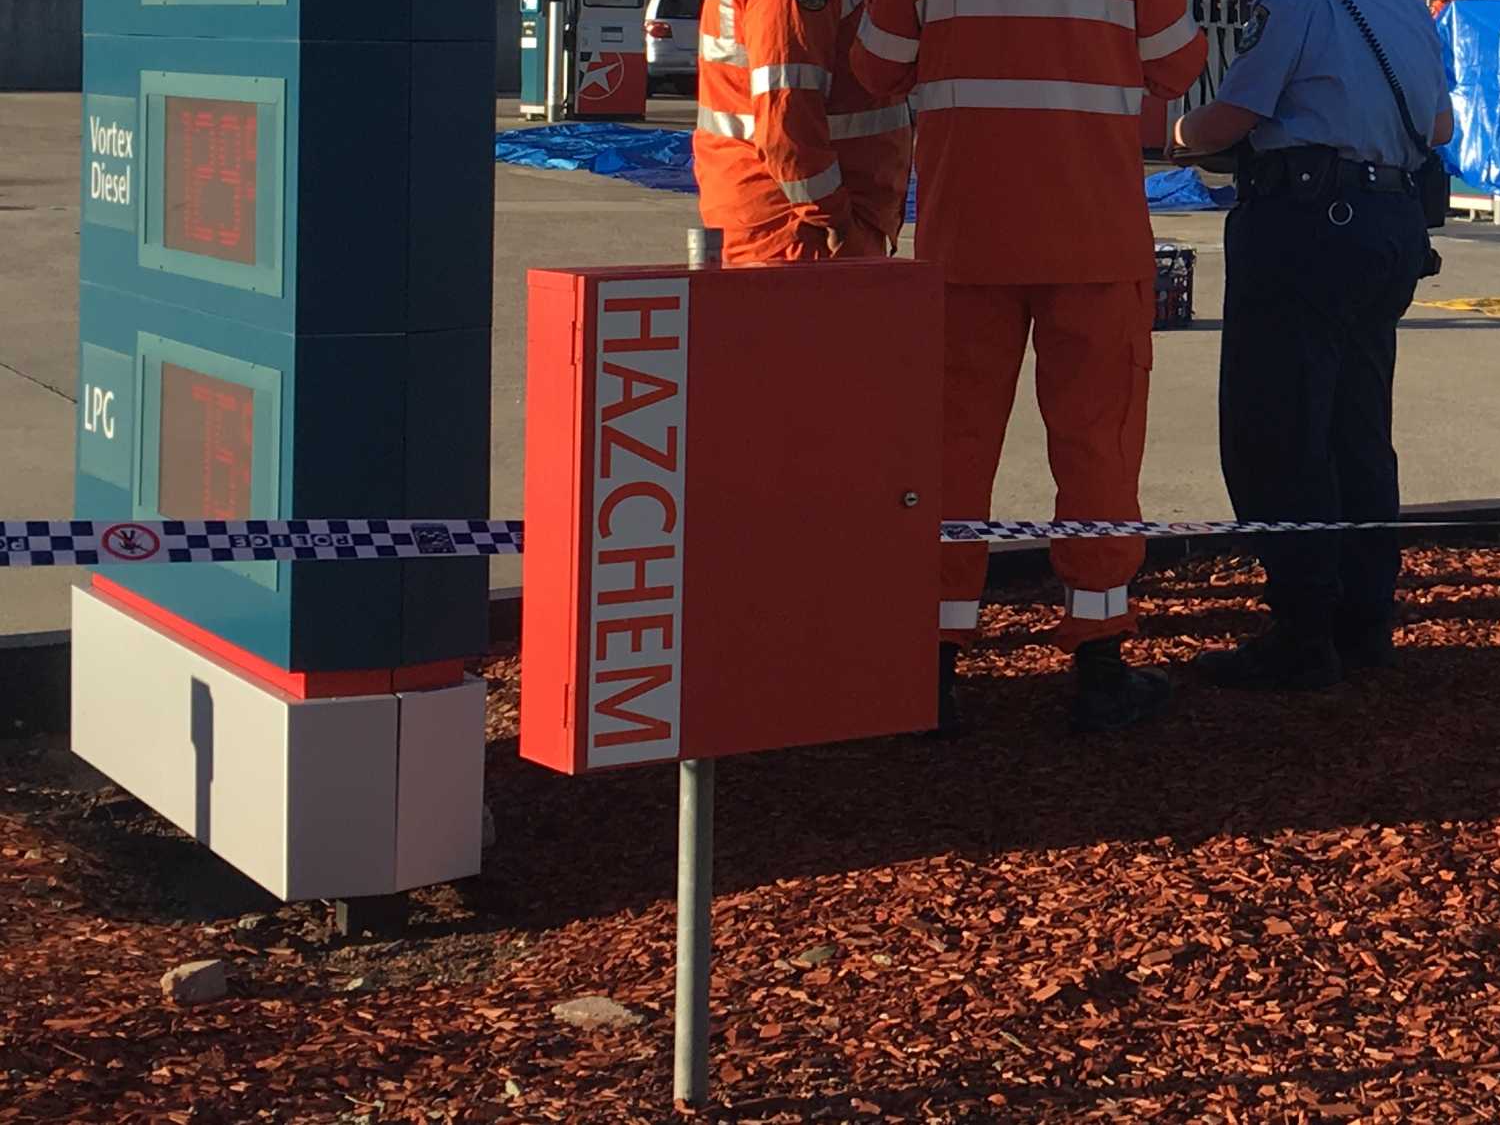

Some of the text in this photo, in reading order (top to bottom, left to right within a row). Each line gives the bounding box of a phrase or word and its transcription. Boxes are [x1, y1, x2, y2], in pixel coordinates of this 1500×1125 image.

[90, 115, 133, 159] Vortex
[90, 161, 131, 206] Diesel
[84, 383, 115, 440] LPG
[230, 534, 350, 548] POLICE
[593, 294, 682, 748] HAZCHEM
